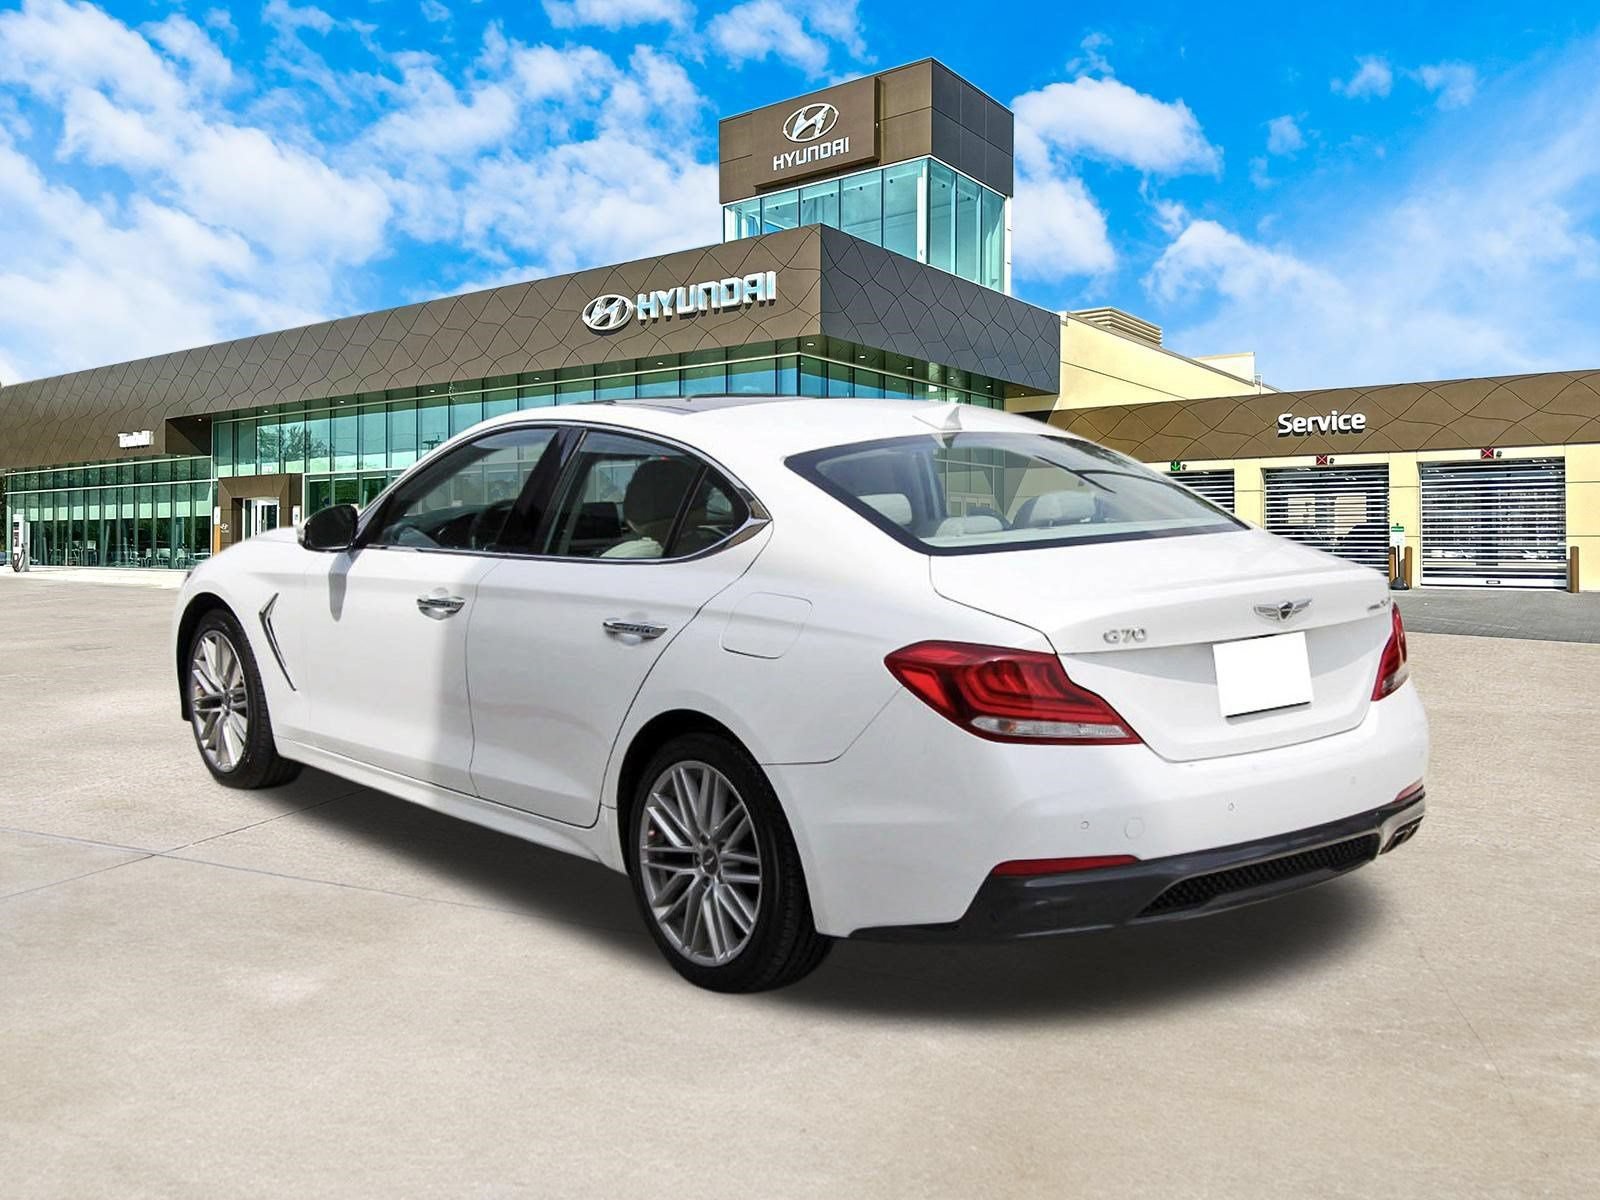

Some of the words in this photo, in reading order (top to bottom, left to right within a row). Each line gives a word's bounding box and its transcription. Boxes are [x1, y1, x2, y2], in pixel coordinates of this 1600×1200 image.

[773, 136, 850, 171] HYUNDAI
[636, 271, 777, 320] HYUNDAI
[1277, 410, 1367, 434] Service
[1103, 628, 1147, 644] G70
